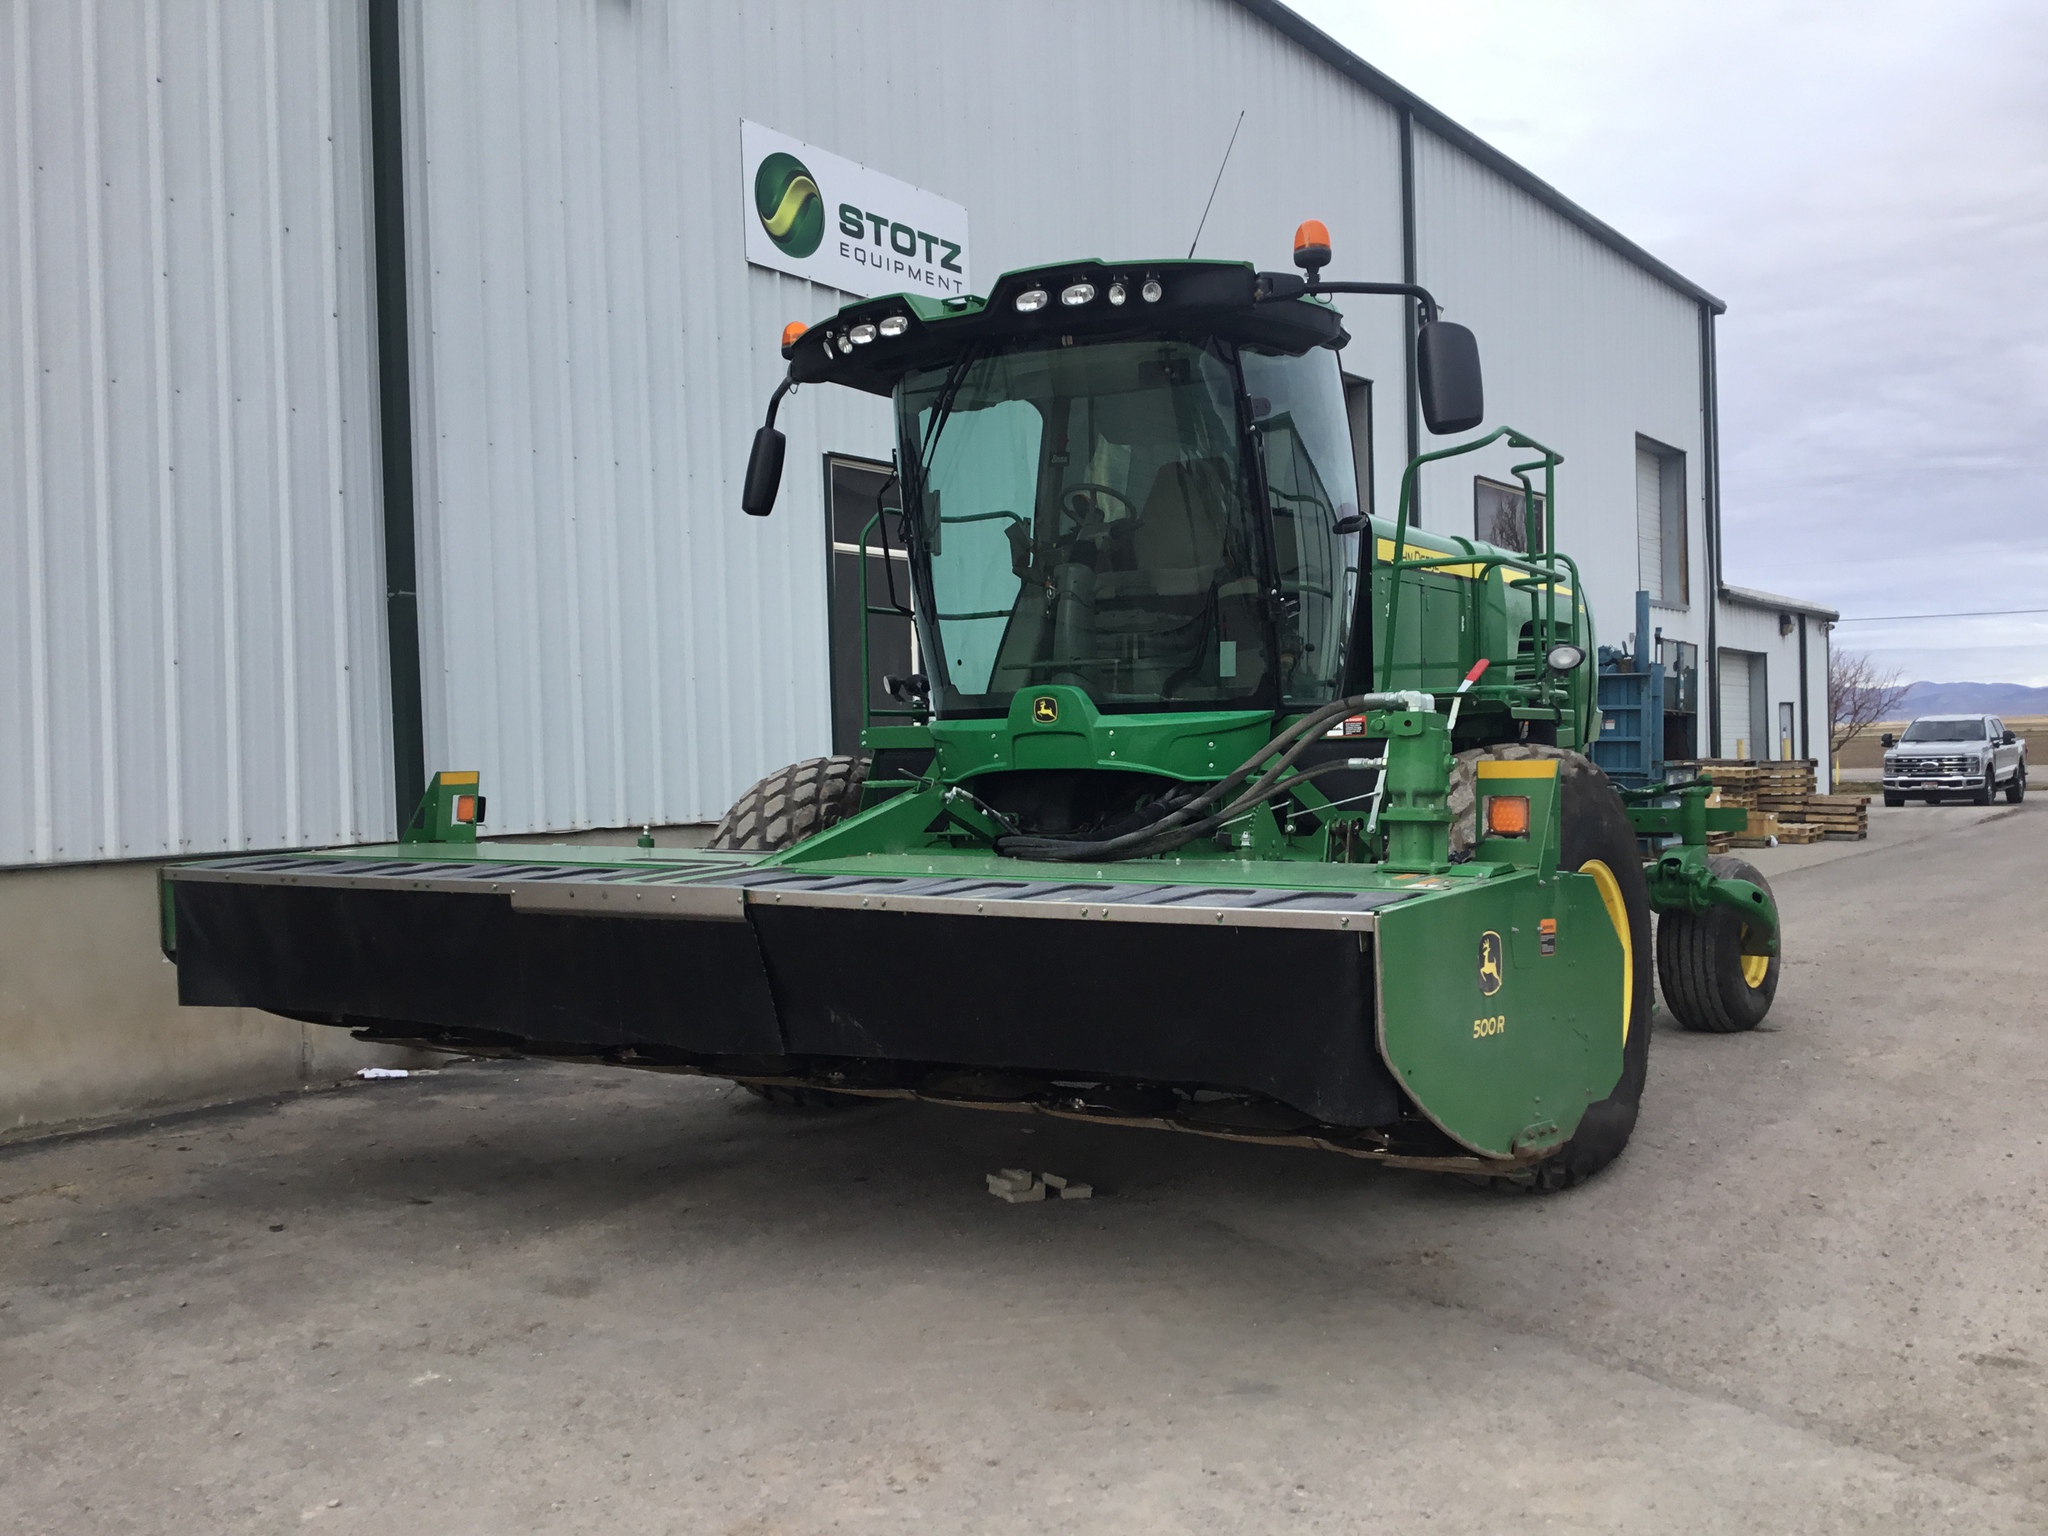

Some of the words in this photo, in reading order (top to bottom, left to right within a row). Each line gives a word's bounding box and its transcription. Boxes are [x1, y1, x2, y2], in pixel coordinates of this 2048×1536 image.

[839, 203, 962, 274] STOTZ
[840, 242, 962, 294] EQUIPMENT
[1473, 1015, 1505, 1039] 500R
